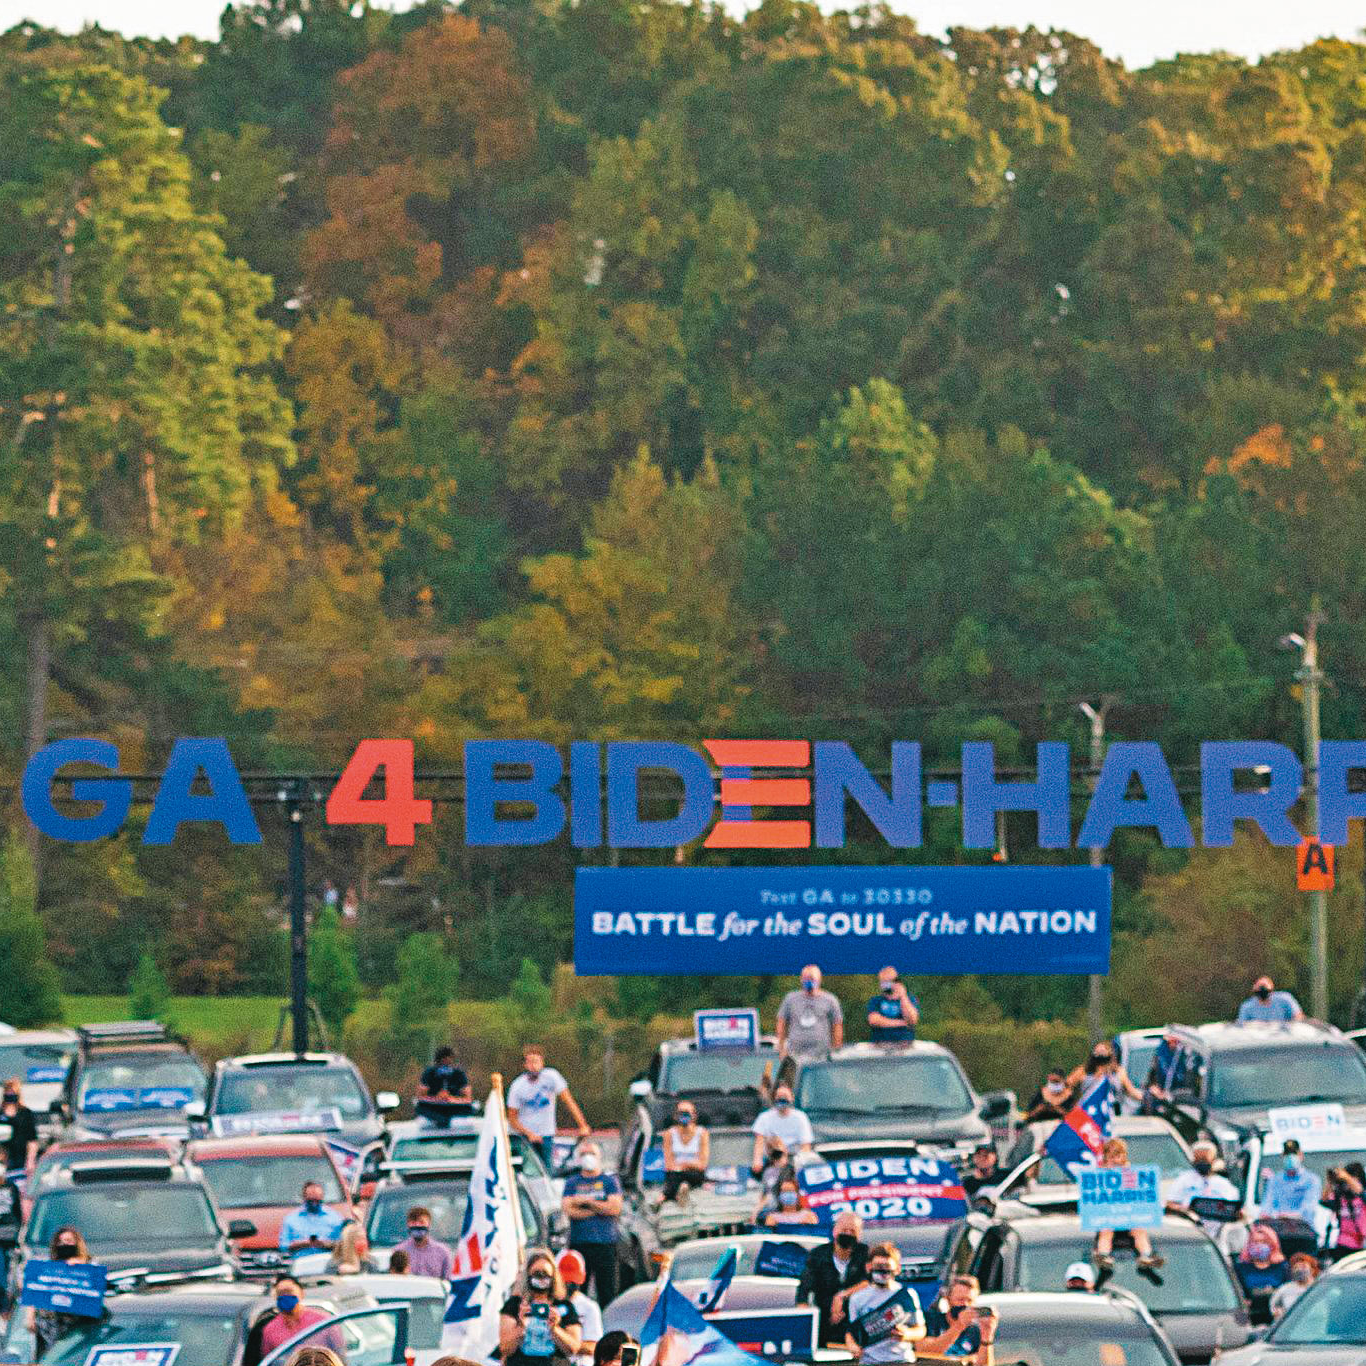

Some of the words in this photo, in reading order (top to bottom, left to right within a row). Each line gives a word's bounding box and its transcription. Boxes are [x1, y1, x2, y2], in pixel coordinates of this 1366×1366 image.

[22, 738, 263, 846] GA
[326, 738, 432, 846] 4
[1302, 842, 1330, 876] A
[802, 888, 834, 904] GA
[863, 888, 932, 904] 30330
[592, 911, 715, 936] BATTLE
[717, 911, 759, 942] for
[763, 911, 802, 936] the
[807, 911, 893, 936] SOUL
[899, 910, 927, 941] of
[929, 911, 967, 935] the
[974, 910, 1096, 935] NATION
[803, 1158, 940, 1186] BIDEN
[1081, 1167, 1157, 1190] BIDEN
[829, 1196, 932, 1221] 2020
